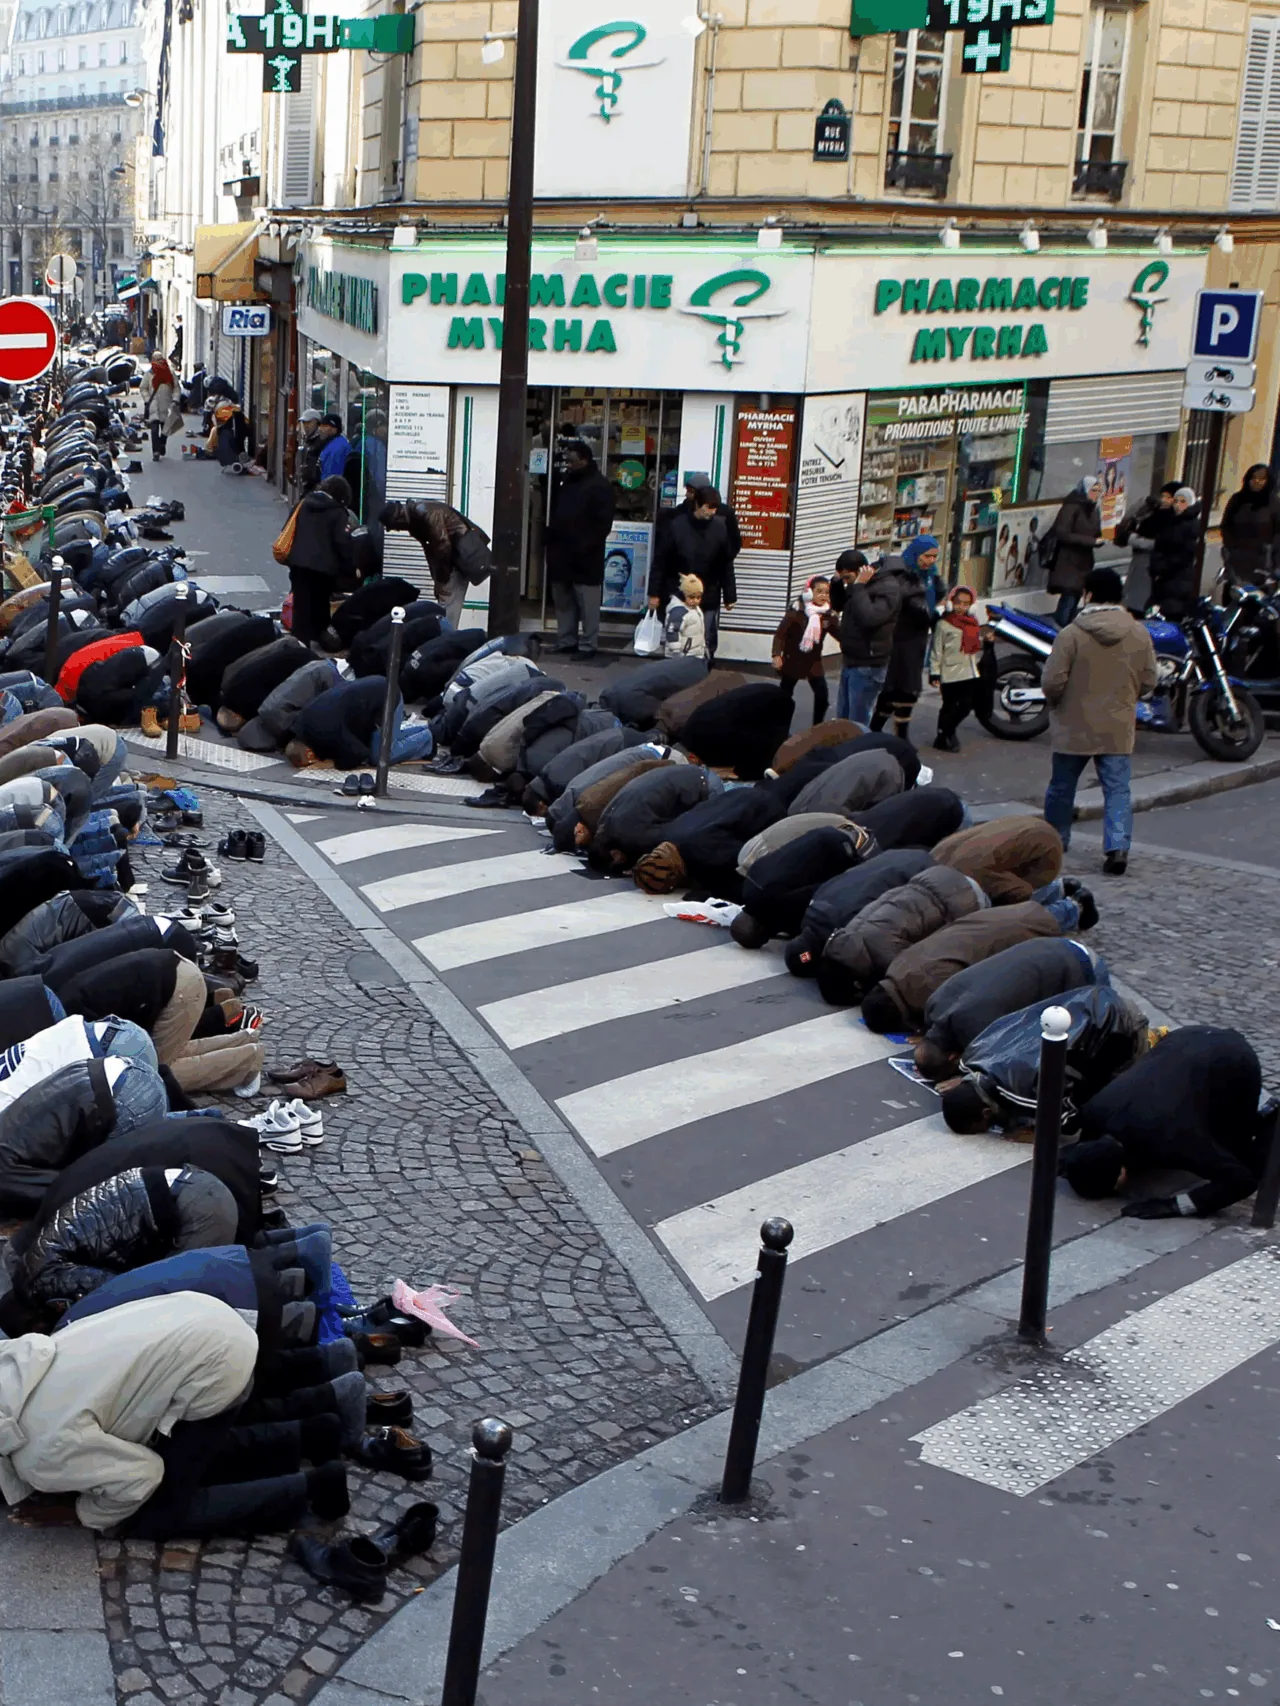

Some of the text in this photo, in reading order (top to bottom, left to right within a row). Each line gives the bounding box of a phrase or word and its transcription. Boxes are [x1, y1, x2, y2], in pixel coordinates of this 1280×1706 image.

[259, 14, 340, 47] 19H
[824, 126, 841, 139] RUE
[818, 140, 845, 152] MYRHA
[875, 276, 1089, 314] PHARMACIE
[229, 309, 266, 329] Ria
[1209, 303, 1239, 346] P
[911, 323, 1049, 361] MYRHA
[897, 389, 1024, 416] PARAPHARMACIE
[738, 412, 795, 423] PHARMACIE
[747, 421, 785, 431] MYRHA
[884, 419, 955, 441] PROMOTIONS
[956, 416, 989, 435] TOUTE
[801, 466, 826, 476] MESURER
[803, 458, 823, 468] ENTREZ
[801, 473, 843, 486] VOTRE TENSION
